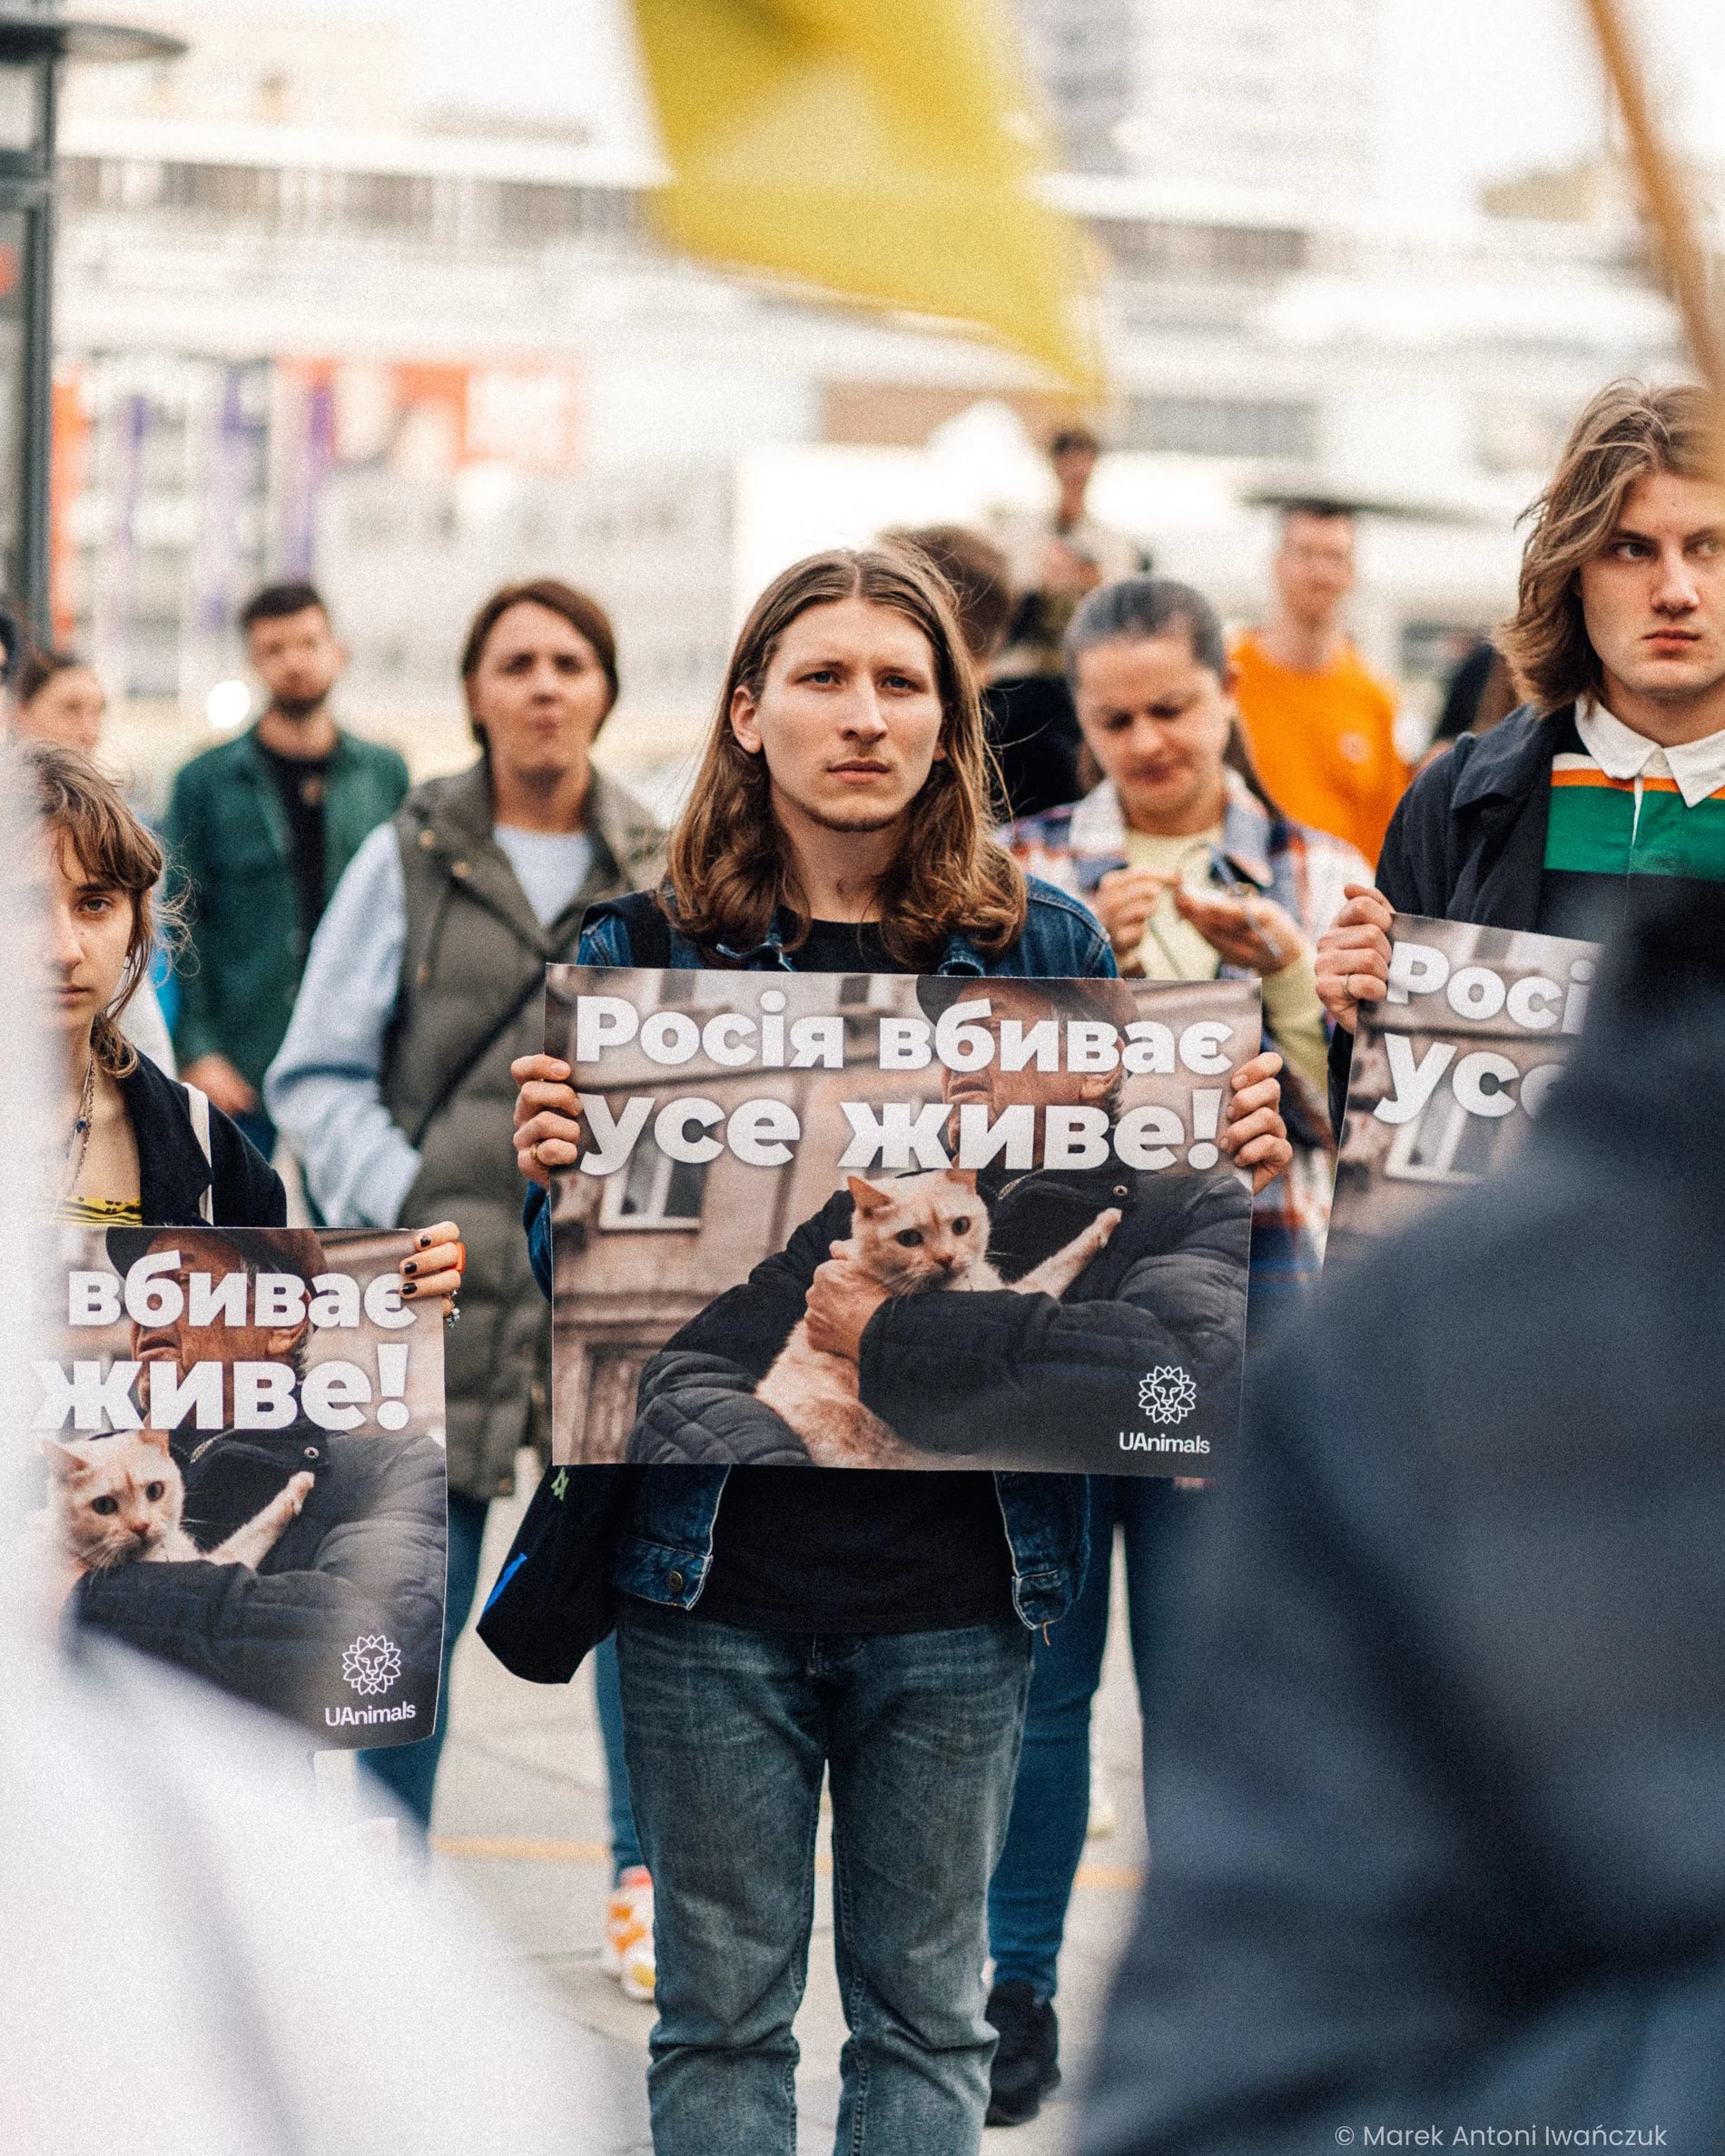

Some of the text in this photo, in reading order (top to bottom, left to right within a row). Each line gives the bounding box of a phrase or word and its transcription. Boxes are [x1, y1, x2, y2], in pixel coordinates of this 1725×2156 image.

[1386, 940, 1595, 1035] Росі
[576, 990, 1233, 1074] Росія вбиває
[580, 1088, 1222, 1176] усе живе!
[68, 1249, 418, 1328] вбиває
[30, 1344, 409, 1431] живе!
[1119, 1432, 1210, 1454] UAnimals
[325, 1700, 416, 1727] UAnimals
